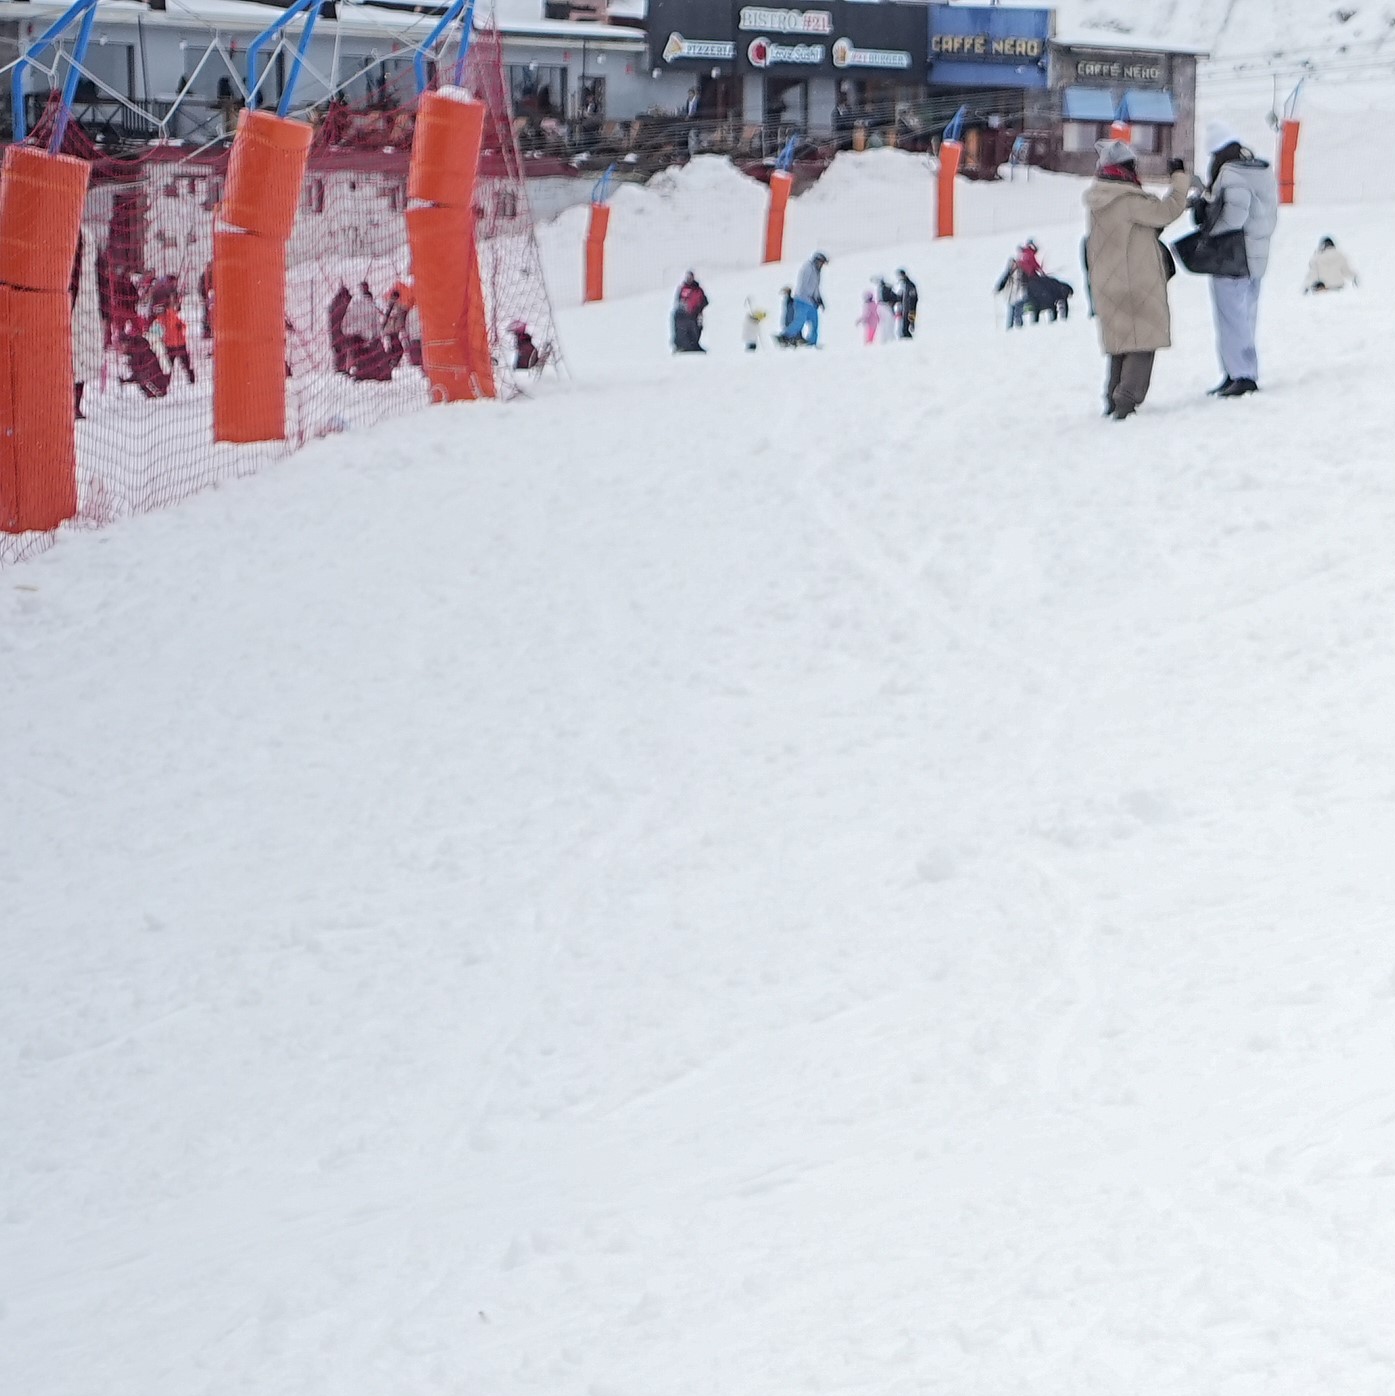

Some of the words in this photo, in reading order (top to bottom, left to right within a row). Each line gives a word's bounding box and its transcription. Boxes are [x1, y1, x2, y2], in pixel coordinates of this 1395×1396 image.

[743, 11, 798, 30] BISTRO
[803, 14, 828, 32] #21
[793, 46, 820, 61] Sushi
[992, 38, 1039, 56] NERO
[868, 53, 905, 65] BURGER
[1124, 64, 1159, 79] NERO
